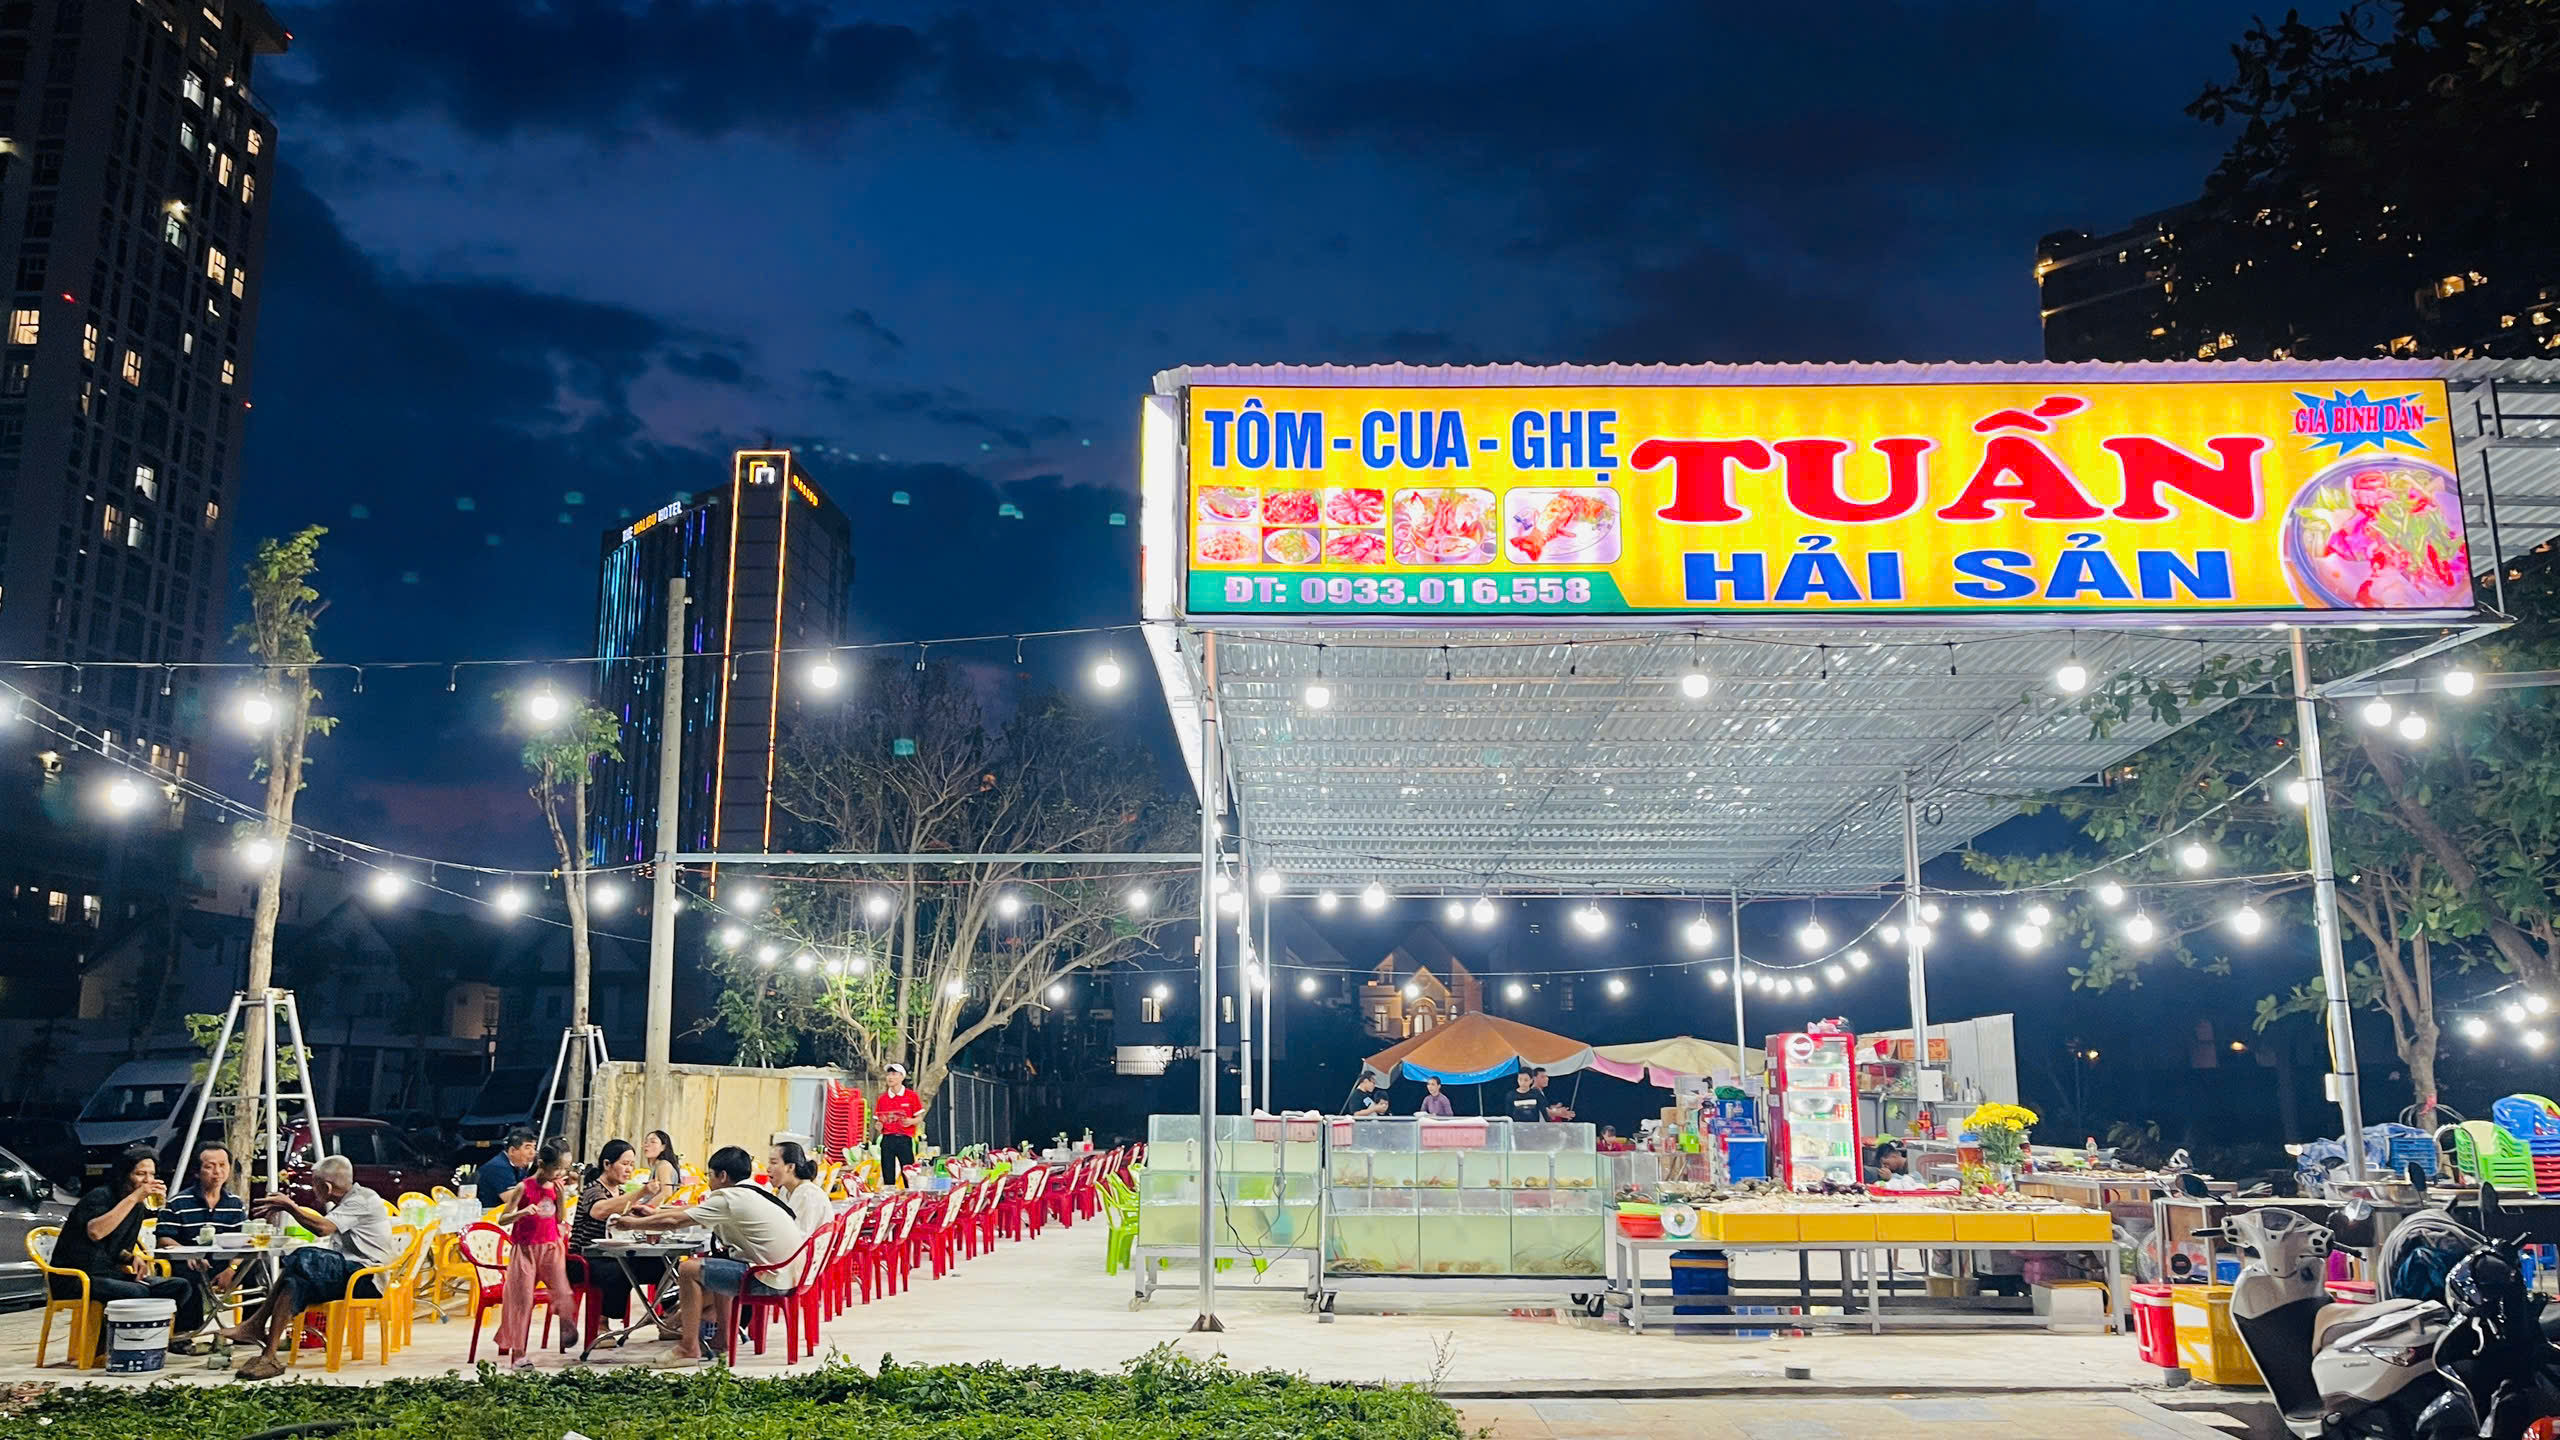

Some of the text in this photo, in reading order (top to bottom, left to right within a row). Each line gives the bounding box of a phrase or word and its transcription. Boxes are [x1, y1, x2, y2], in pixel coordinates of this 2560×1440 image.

[1204, 398, 1323, 469] TÔM
[1361, 410, 1469, 469] CUA
[1511, 410, 1618, 482] GHẸ
[2295, 399, 2328, 433] GIÁ
[2383, 397, 2424, 431] DÂN
[1629, 396, 2266, 523] TUẤN
[1223, 576, 1592, 604] ĐT: 0933.016.558
[1684, 533, 2232, 601] HẢI SẢN
